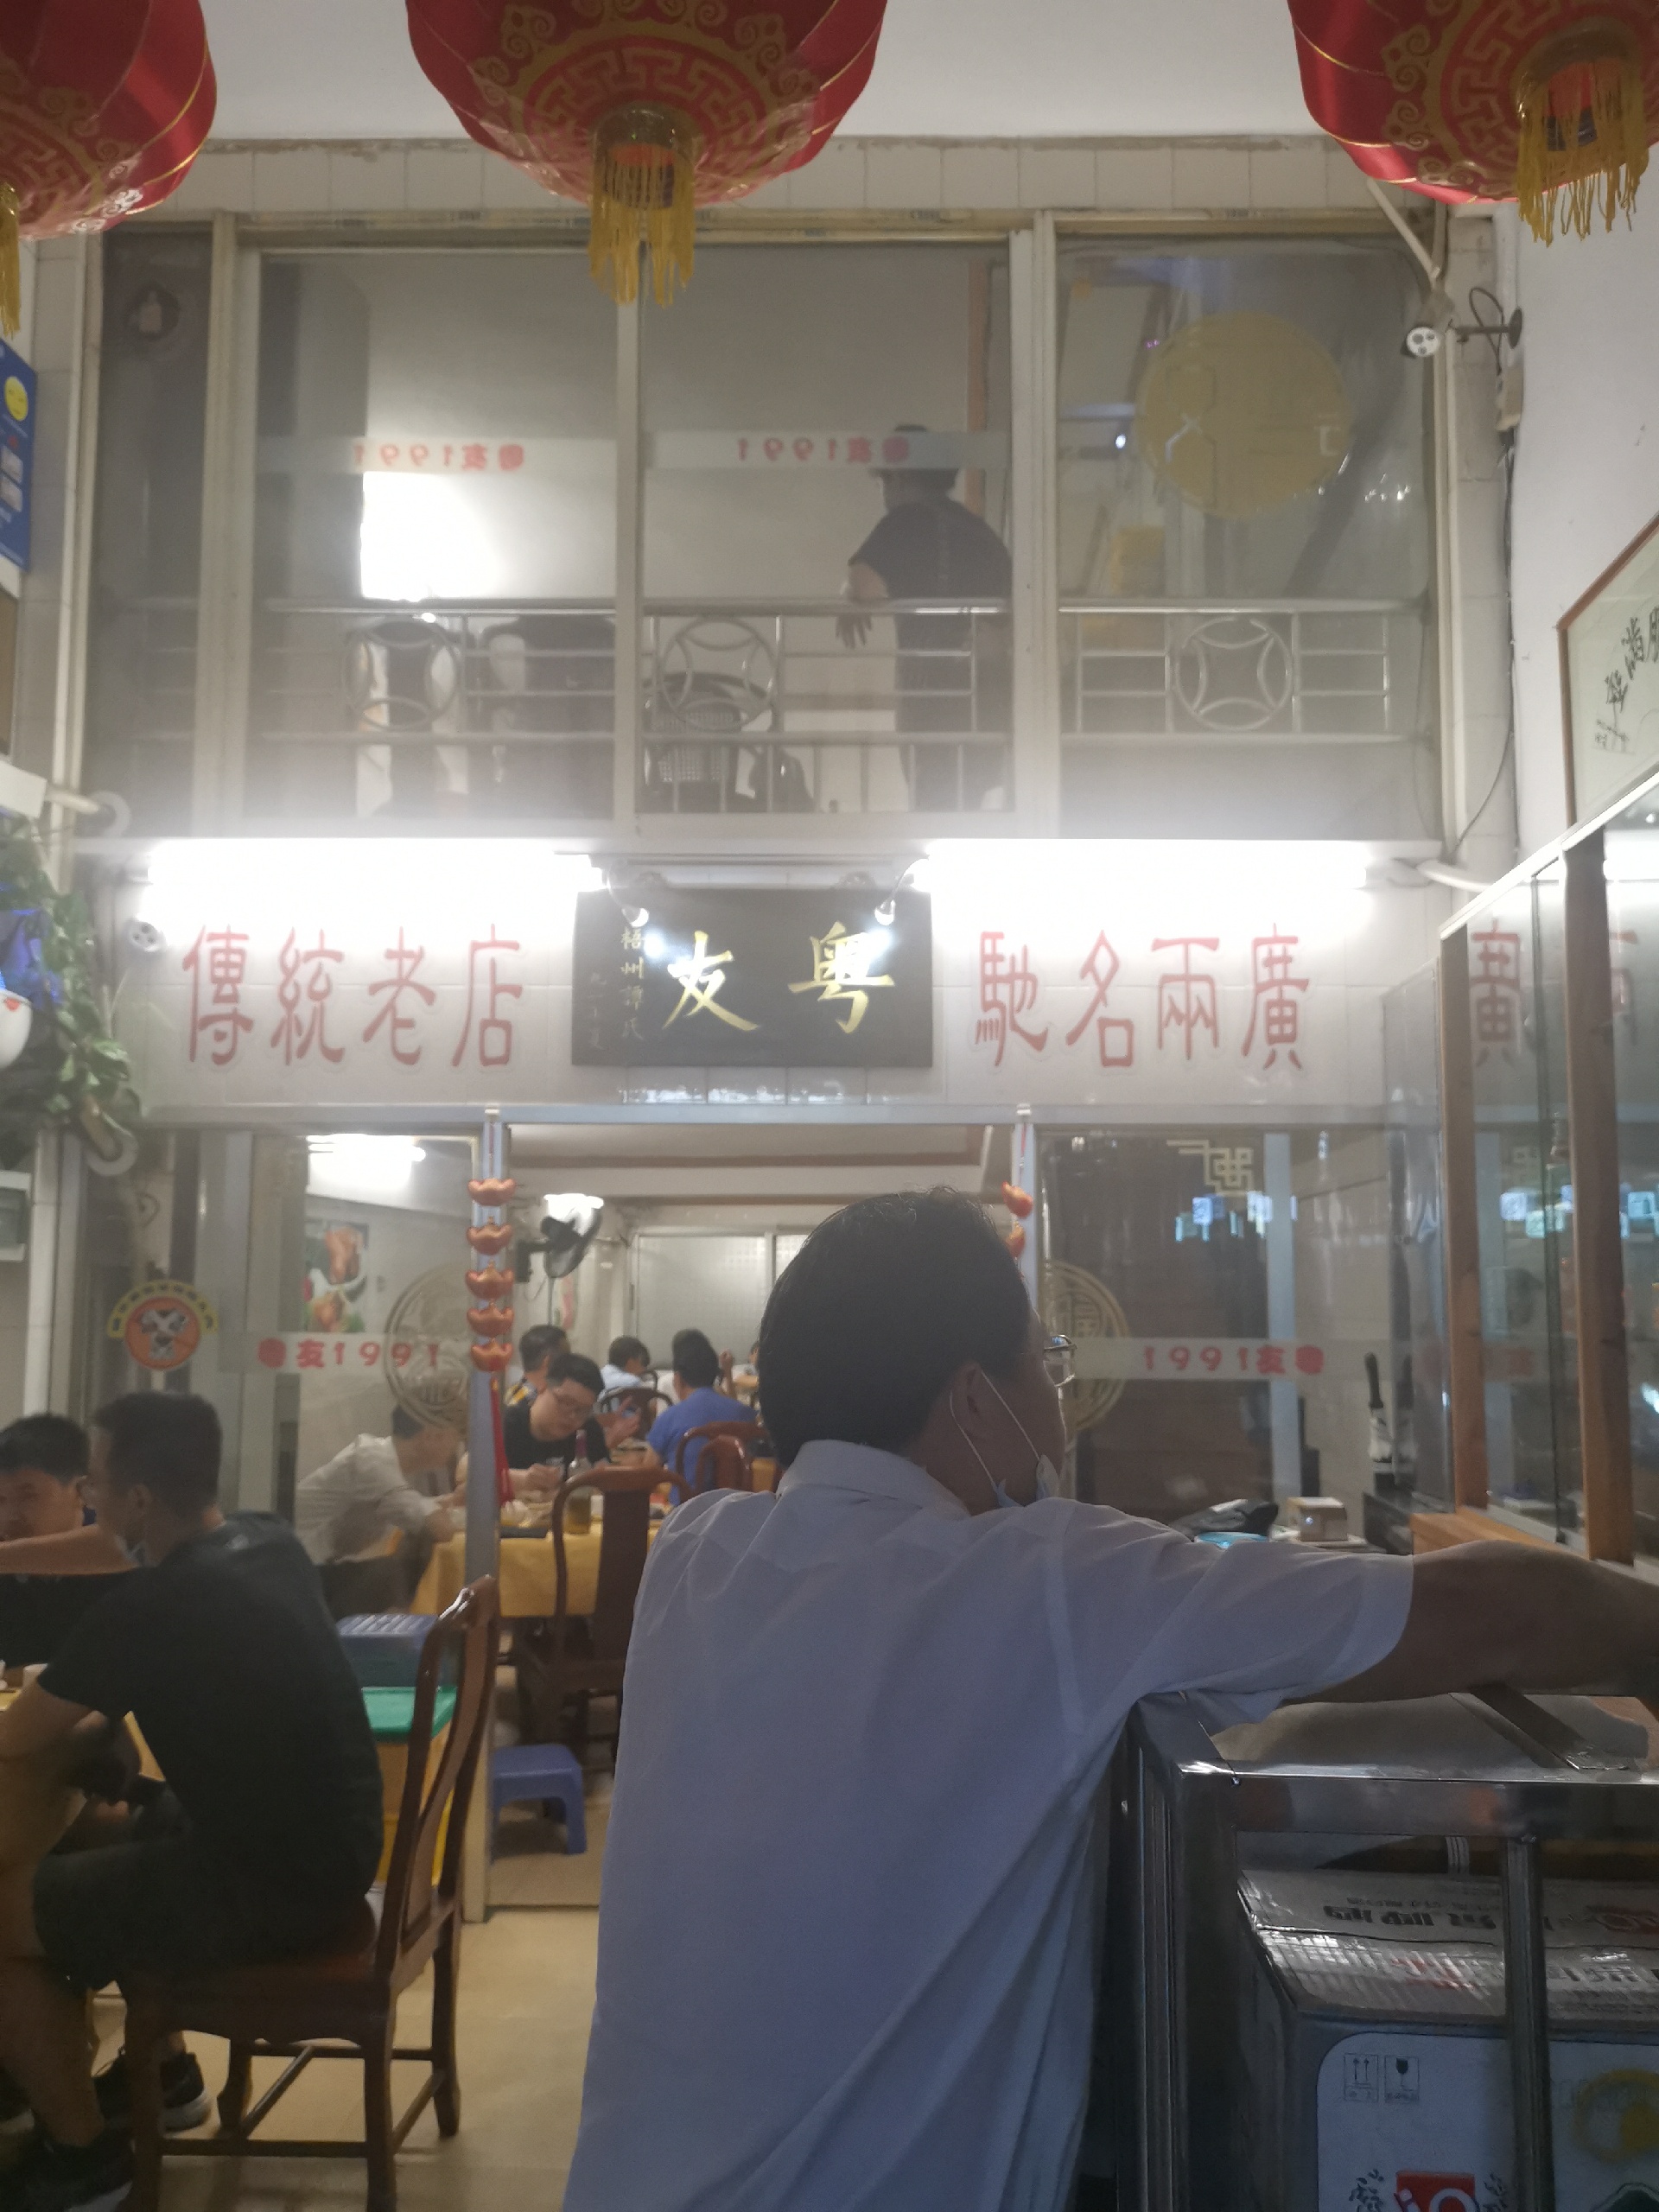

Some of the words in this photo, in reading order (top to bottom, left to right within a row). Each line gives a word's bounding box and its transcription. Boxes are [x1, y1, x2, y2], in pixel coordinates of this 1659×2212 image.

[182, 923, 523, 1067] 傳統老店
[975, 923, 1310, 1071] 馳名兩廣
